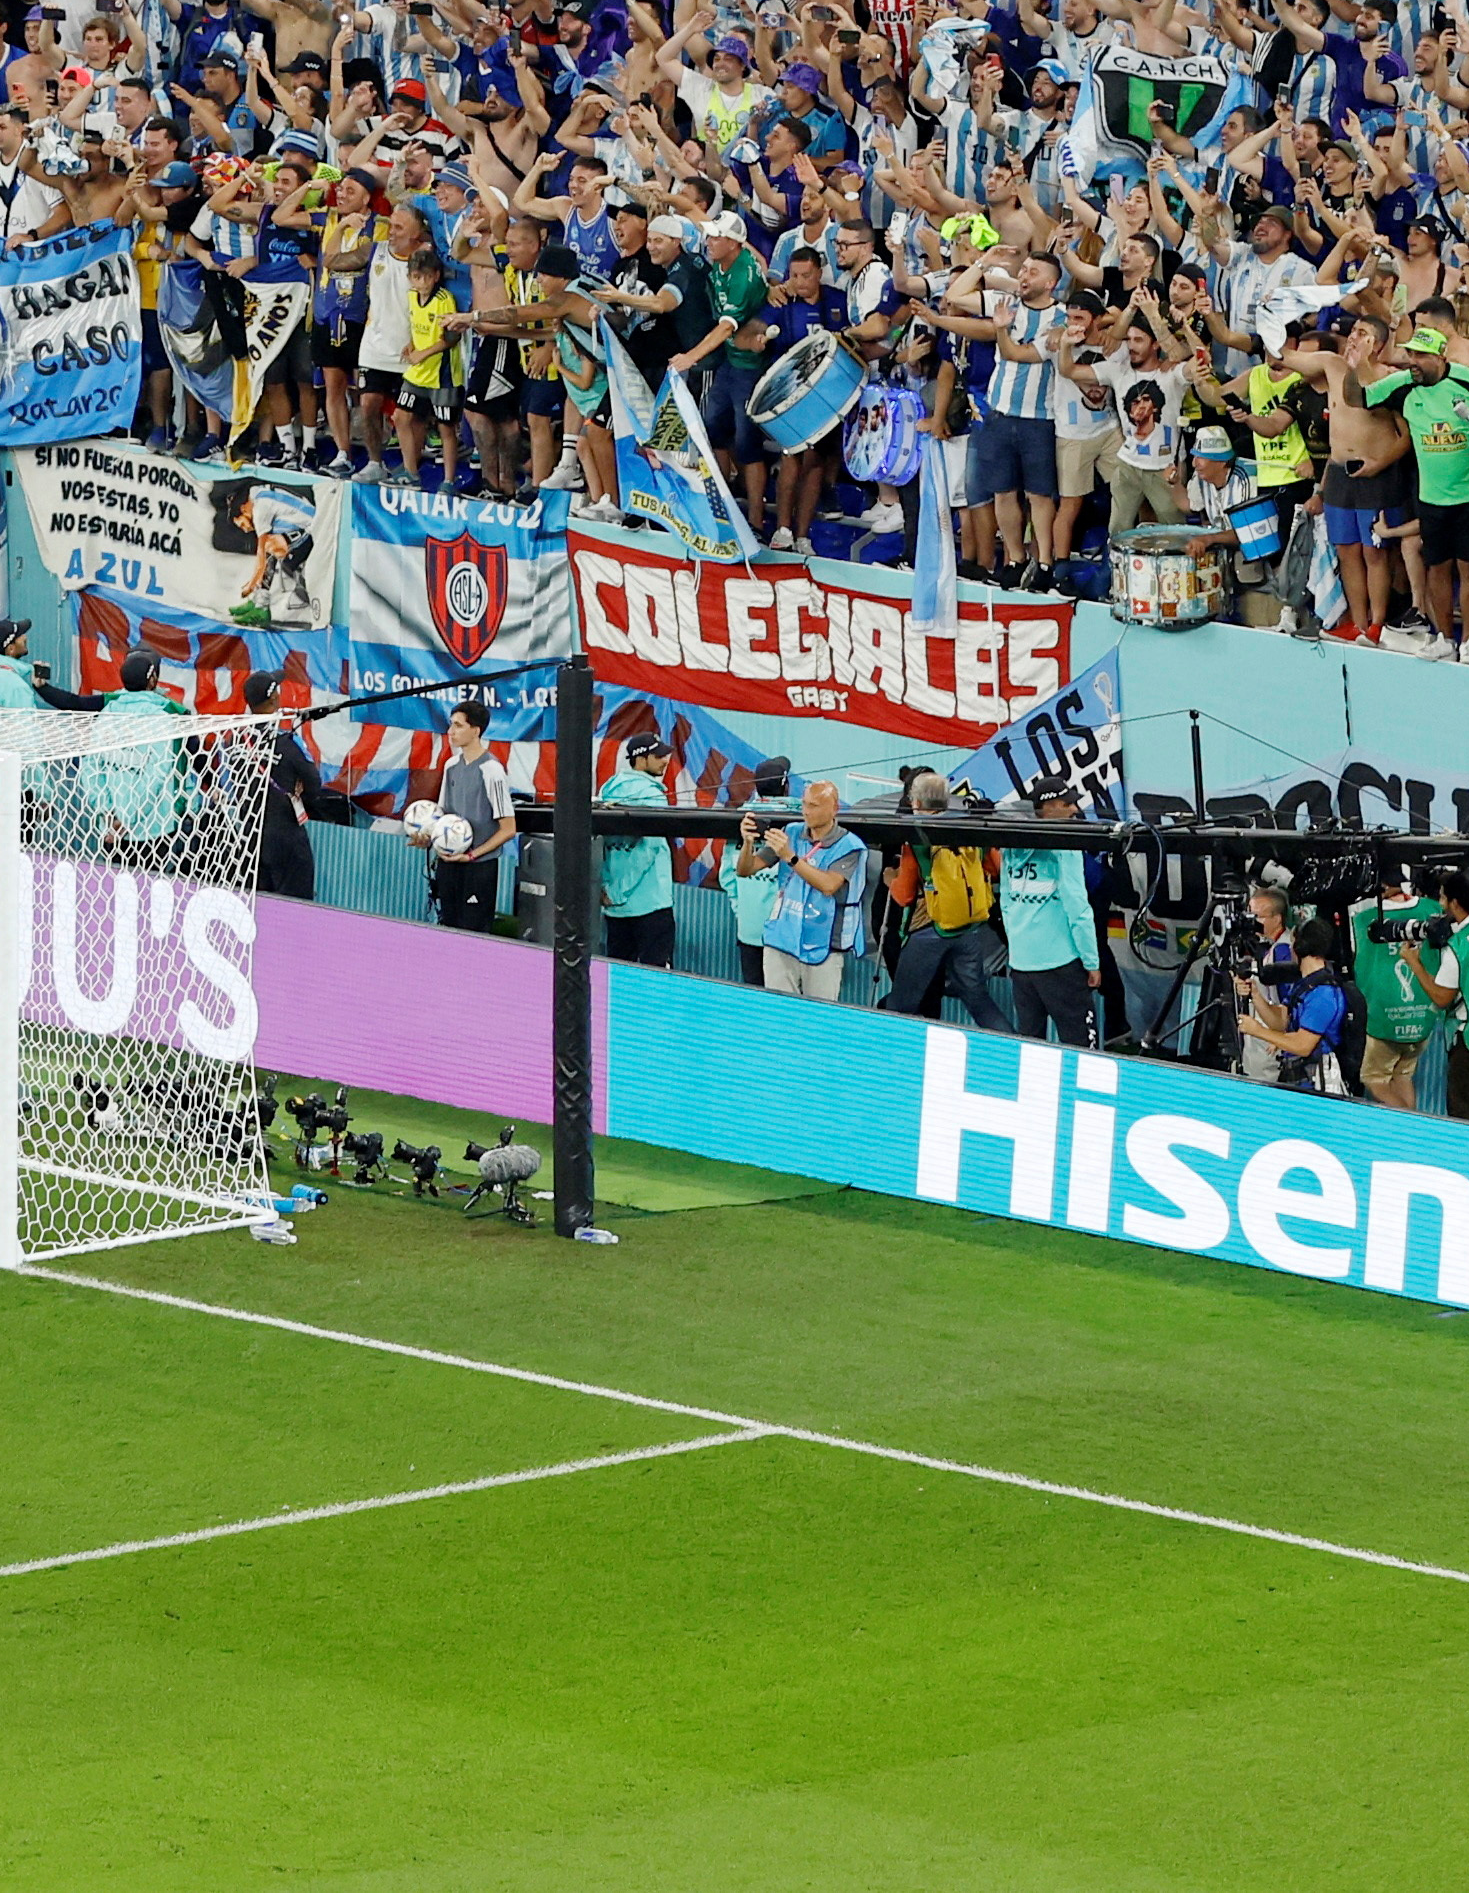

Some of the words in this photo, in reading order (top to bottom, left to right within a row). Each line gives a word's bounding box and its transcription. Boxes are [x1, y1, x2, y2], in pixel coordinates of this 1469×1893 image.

[31, 319, 131, 378] CASO
[33, 446, 52, 467] SI
[55, 446, 82, 471] NO
[84, 449, 136, 482] FUERA
[137, 462, 199, 503] PORQUE
[49, 510, 77, 535] NO
[60, 478, 99, 504] VOS
[158, 500, 180, 524] YO
[379, 488, 469, 521] QATAR
[571, 548, 1059, 725] COLEGIALES
[353, 669, 387, 693] LOS
[994, 689, 1100, 800] LOS
